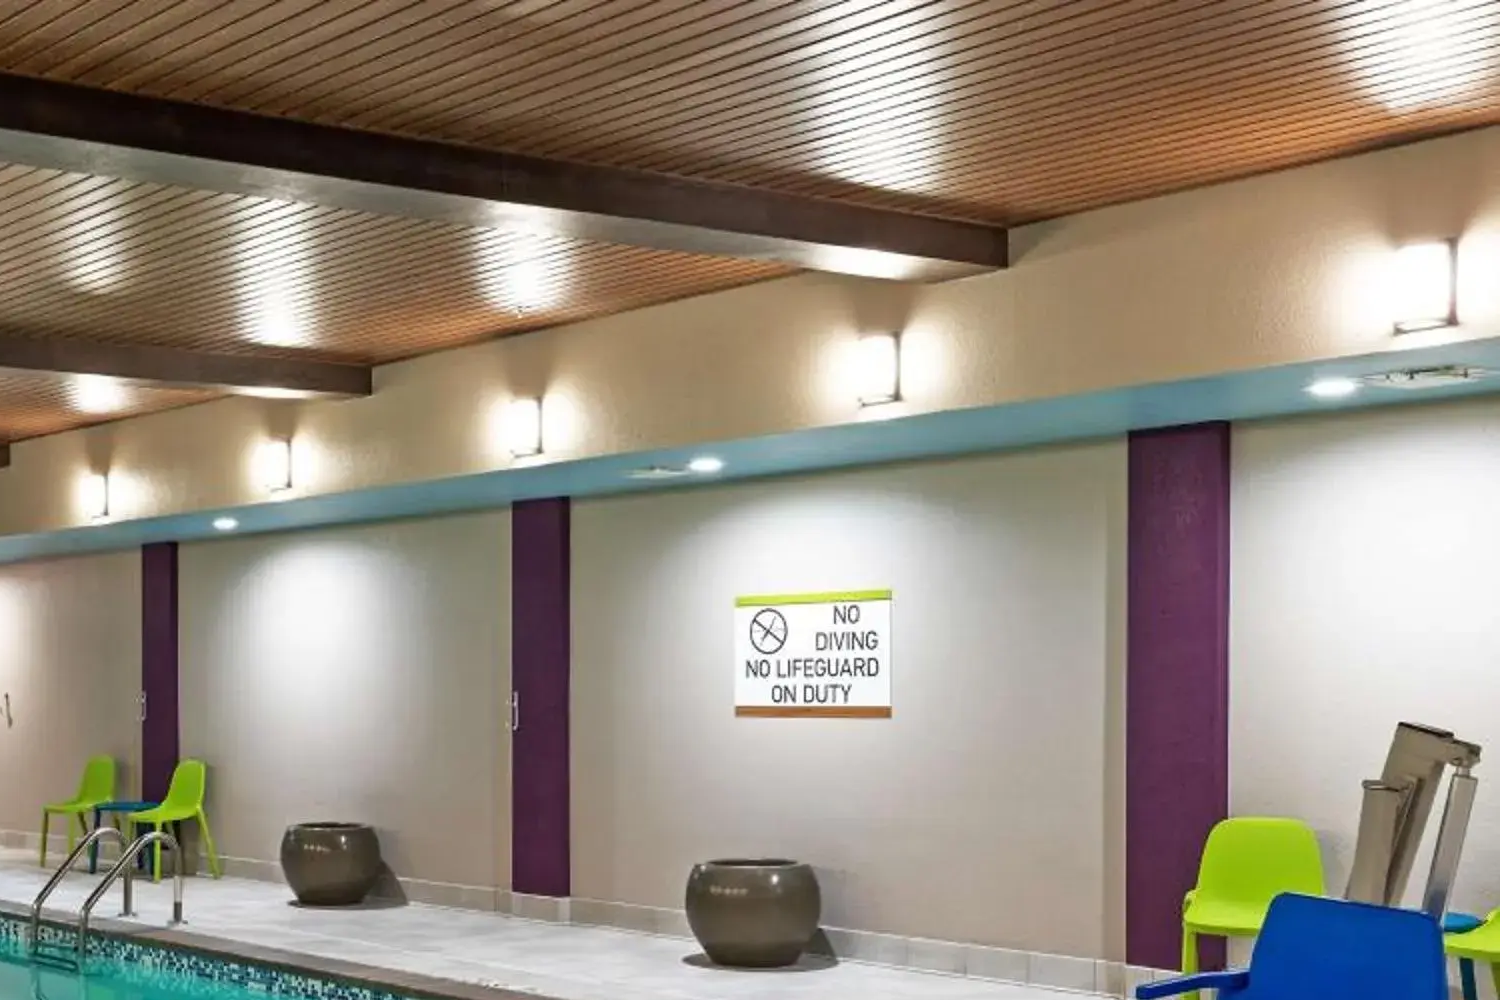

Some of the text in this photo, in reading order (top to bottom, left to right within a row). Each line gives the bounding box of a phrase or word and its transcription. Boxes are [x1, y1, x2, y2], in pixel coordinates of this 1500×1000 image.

[833, 604, 861, 625] NO
[815, 630, 879, 651] DIVING
[745, 657, 880, 679] NO LIFEGUARD
[771, 684, 853, 704] ON DUTY
